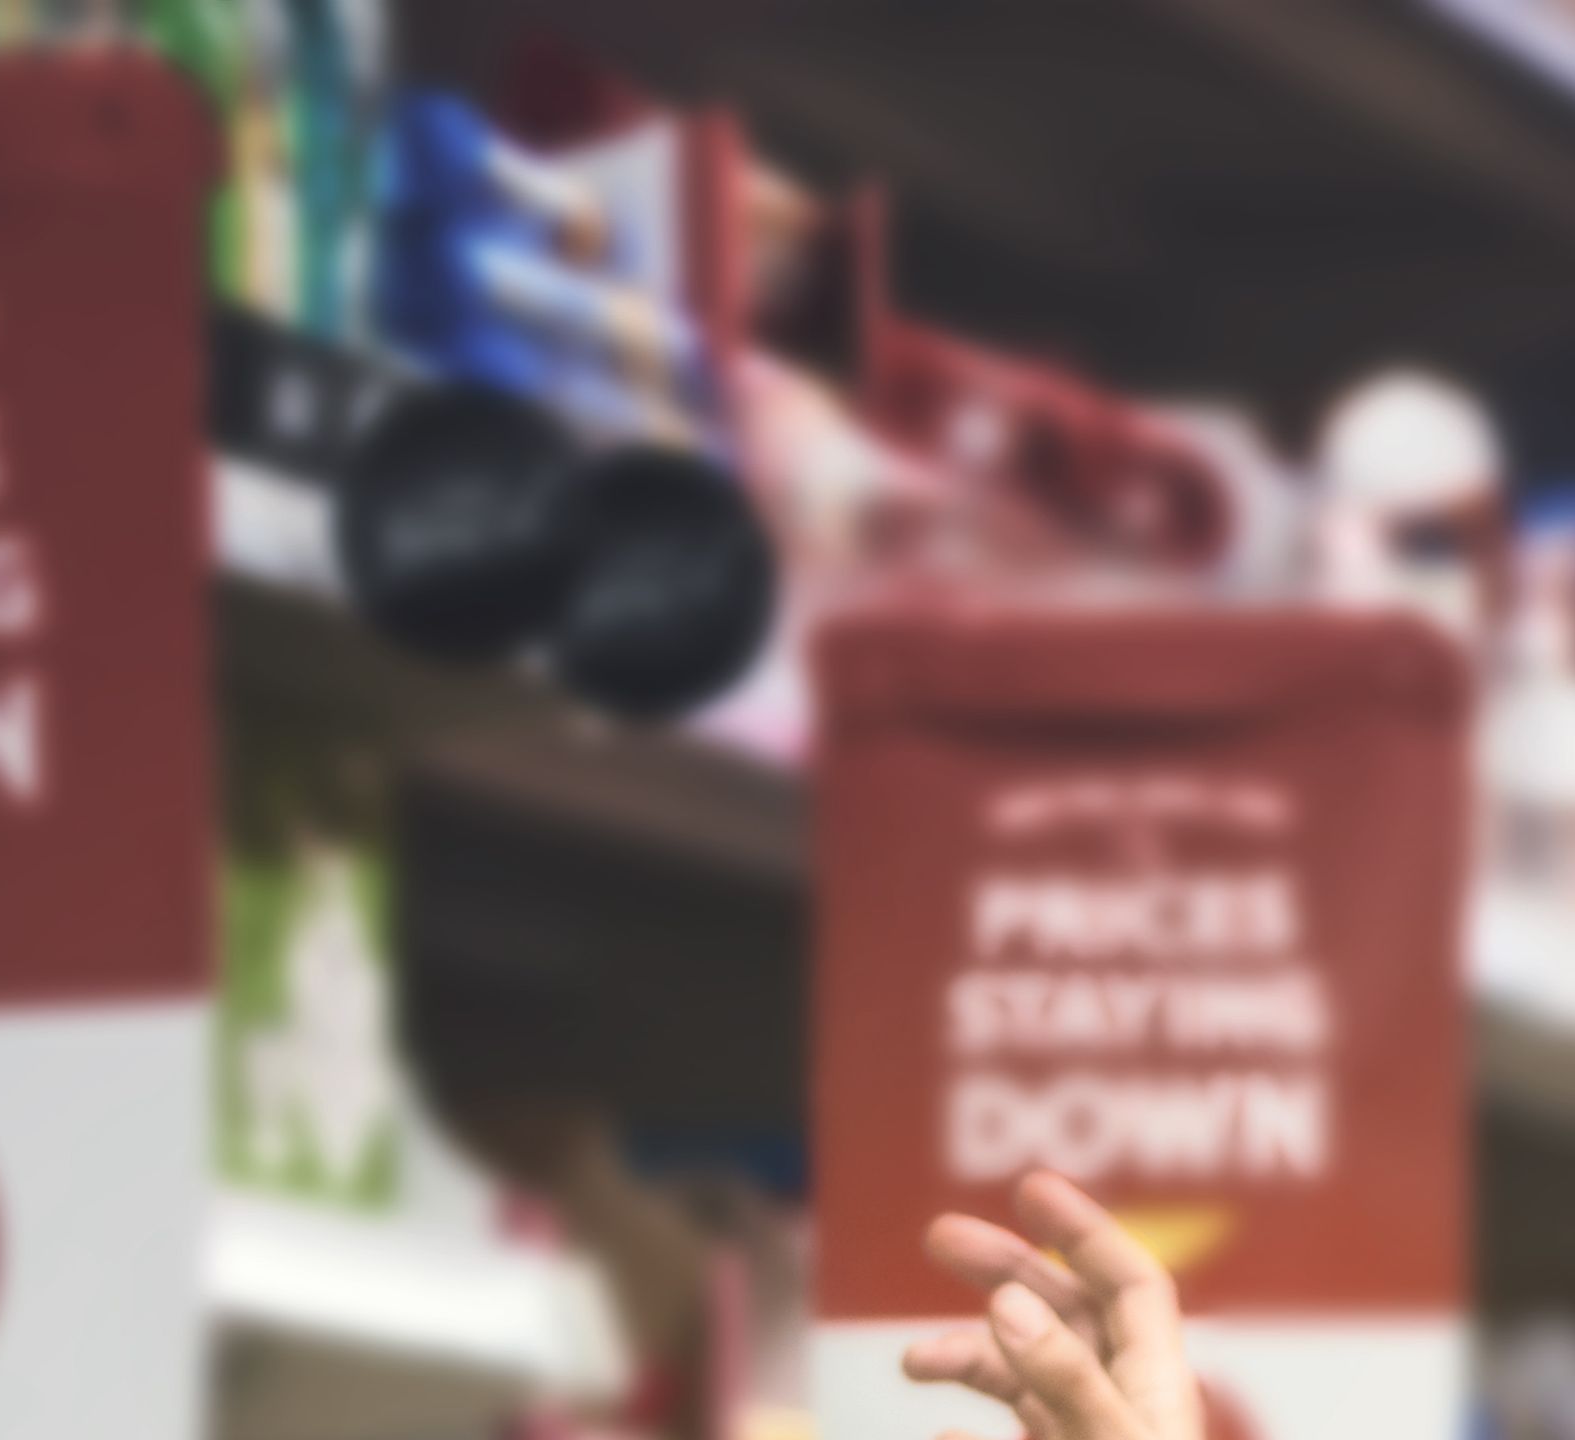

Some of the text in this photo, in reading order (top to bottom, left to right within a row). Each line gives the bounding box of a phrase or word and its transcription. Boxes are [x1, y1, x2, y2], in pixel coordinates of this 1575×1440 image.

[974, 872, 1297, 958] PRICES
[946, 970, 1328, 1055] STAYING
[947, 1074, 1331, 1182] DOWN
